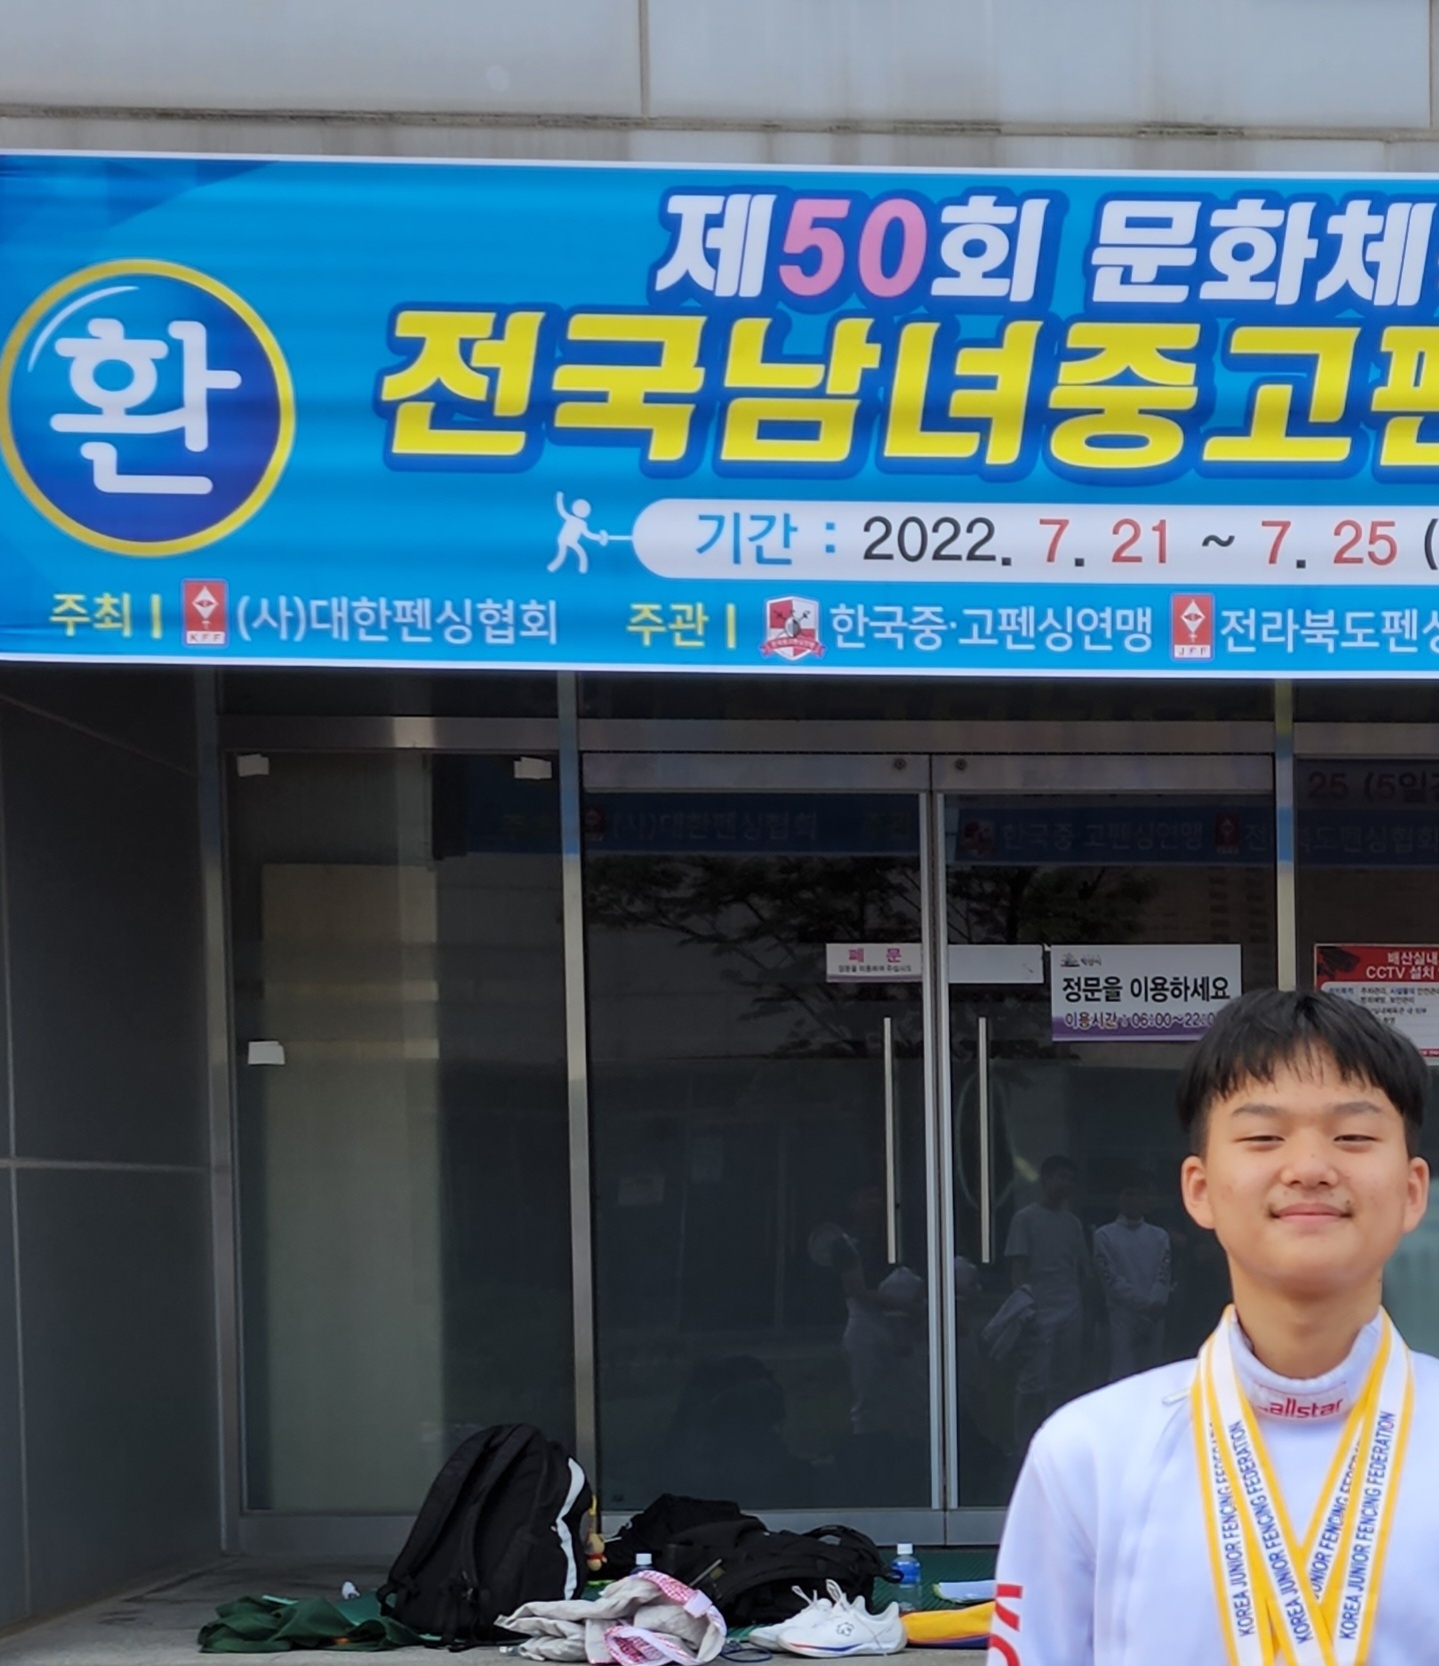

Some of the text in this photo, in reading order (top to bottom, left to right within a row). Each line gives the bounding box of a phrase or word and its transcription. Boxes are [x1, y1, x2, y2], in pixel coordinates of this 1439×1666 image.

[653, 192, 1050, 304] 제50회
[49, 317, 242, 496] 환
[695, 511, 799, 566] 기간
[862, 515, 1013, 567] 2022.
[1111, 517, 1169, 565] 21
[1332, 519, 1398, 567] 25
[48, 592, 133, 638] 주최
[236, 595, 559, 647] (사)대한펜싱협회
[626, 601, 710, 649] 주관
[1062, 975, 1231, 1003] 정문을 이용하세요
[1366, 966, 1406, 979] CCTV
[1066, 1011, 1118, 1030] 이용시간
[1268, 1397, 1344, 1419] allstar
[1228, 1419, 1314, 1645] KOREA JUNIOR FENCING FEDERATION
[1339, 1410, 1396, 1640] KOREA JUNIOR FENCING FEDERATION
[1225, 1540, 1248, 1587] JUNIOR
[1232, 1589, 1256, 1638] KOREA
